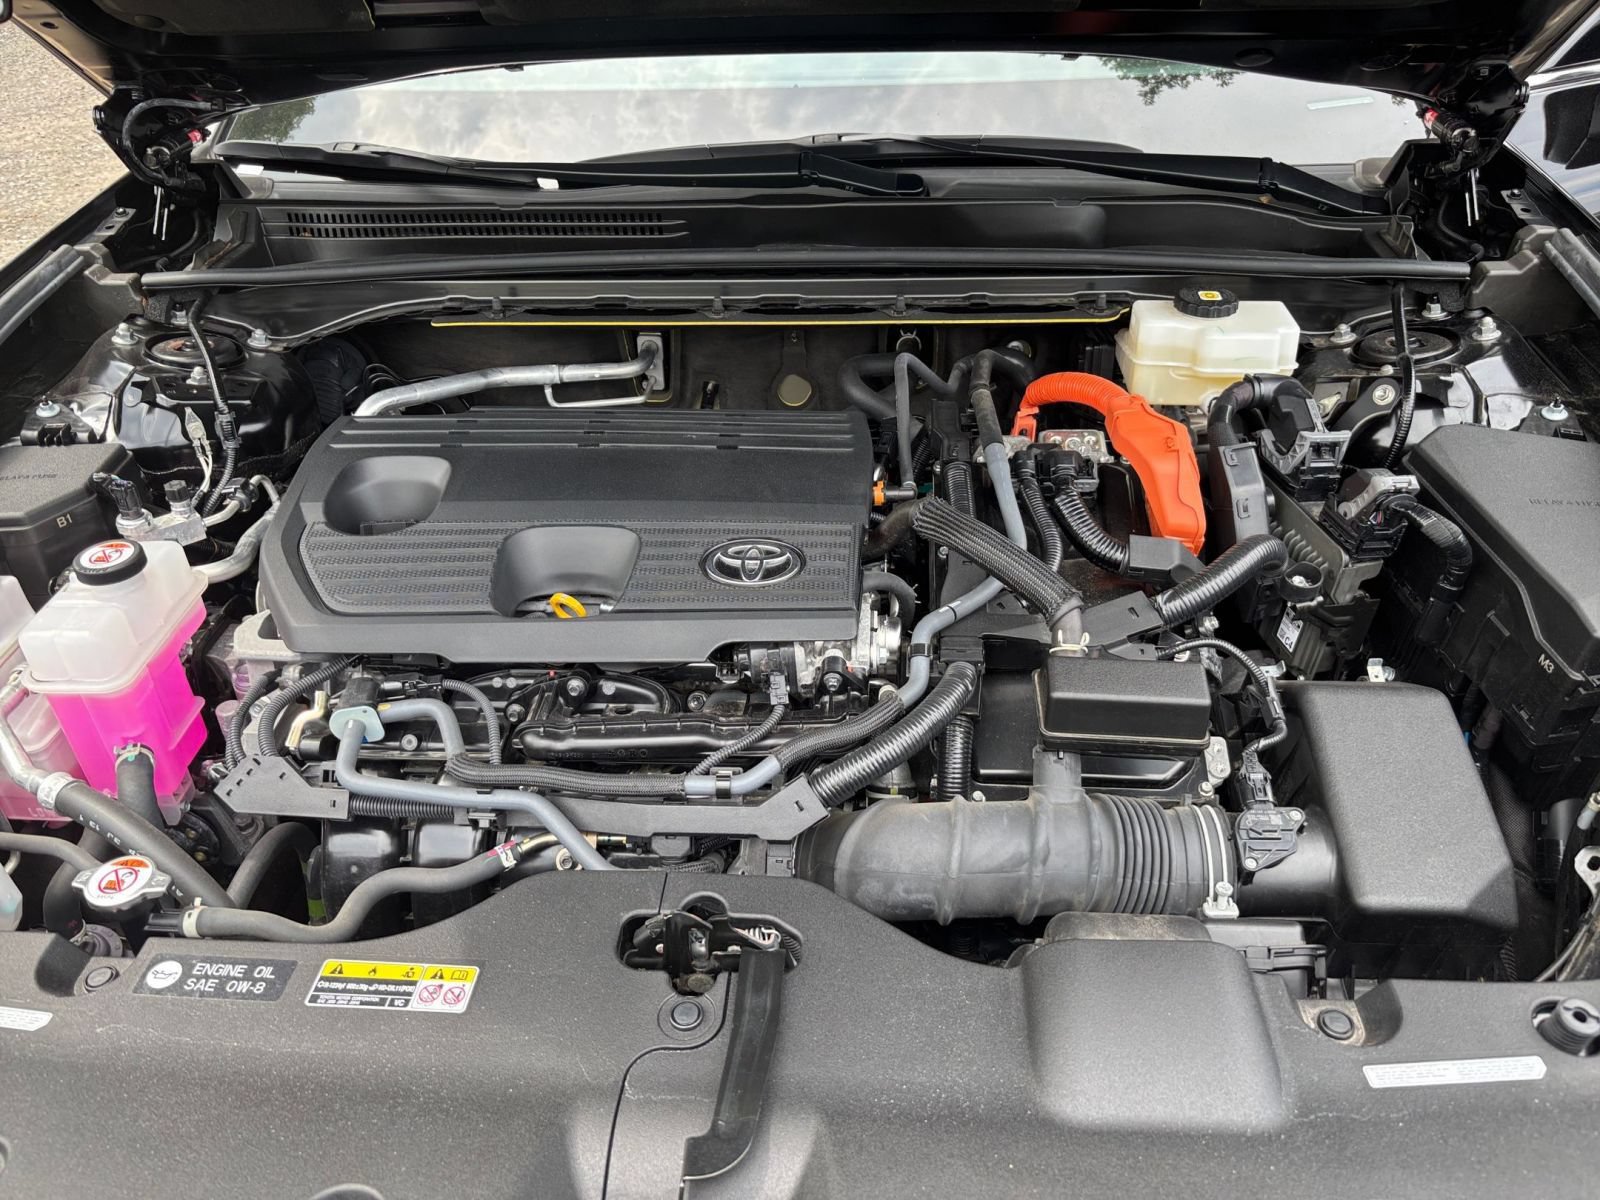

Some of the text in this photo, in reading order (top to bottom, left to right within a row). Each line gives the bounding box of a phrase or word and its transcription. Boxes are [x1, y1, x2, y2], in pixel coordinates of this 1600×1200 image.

[56, 513, 73, 528] B1
[1538, 653, 1554, 673] M3
[192, 962, 276, 979] ENGINE OIL
[183, 978, 219, 992] SAE
